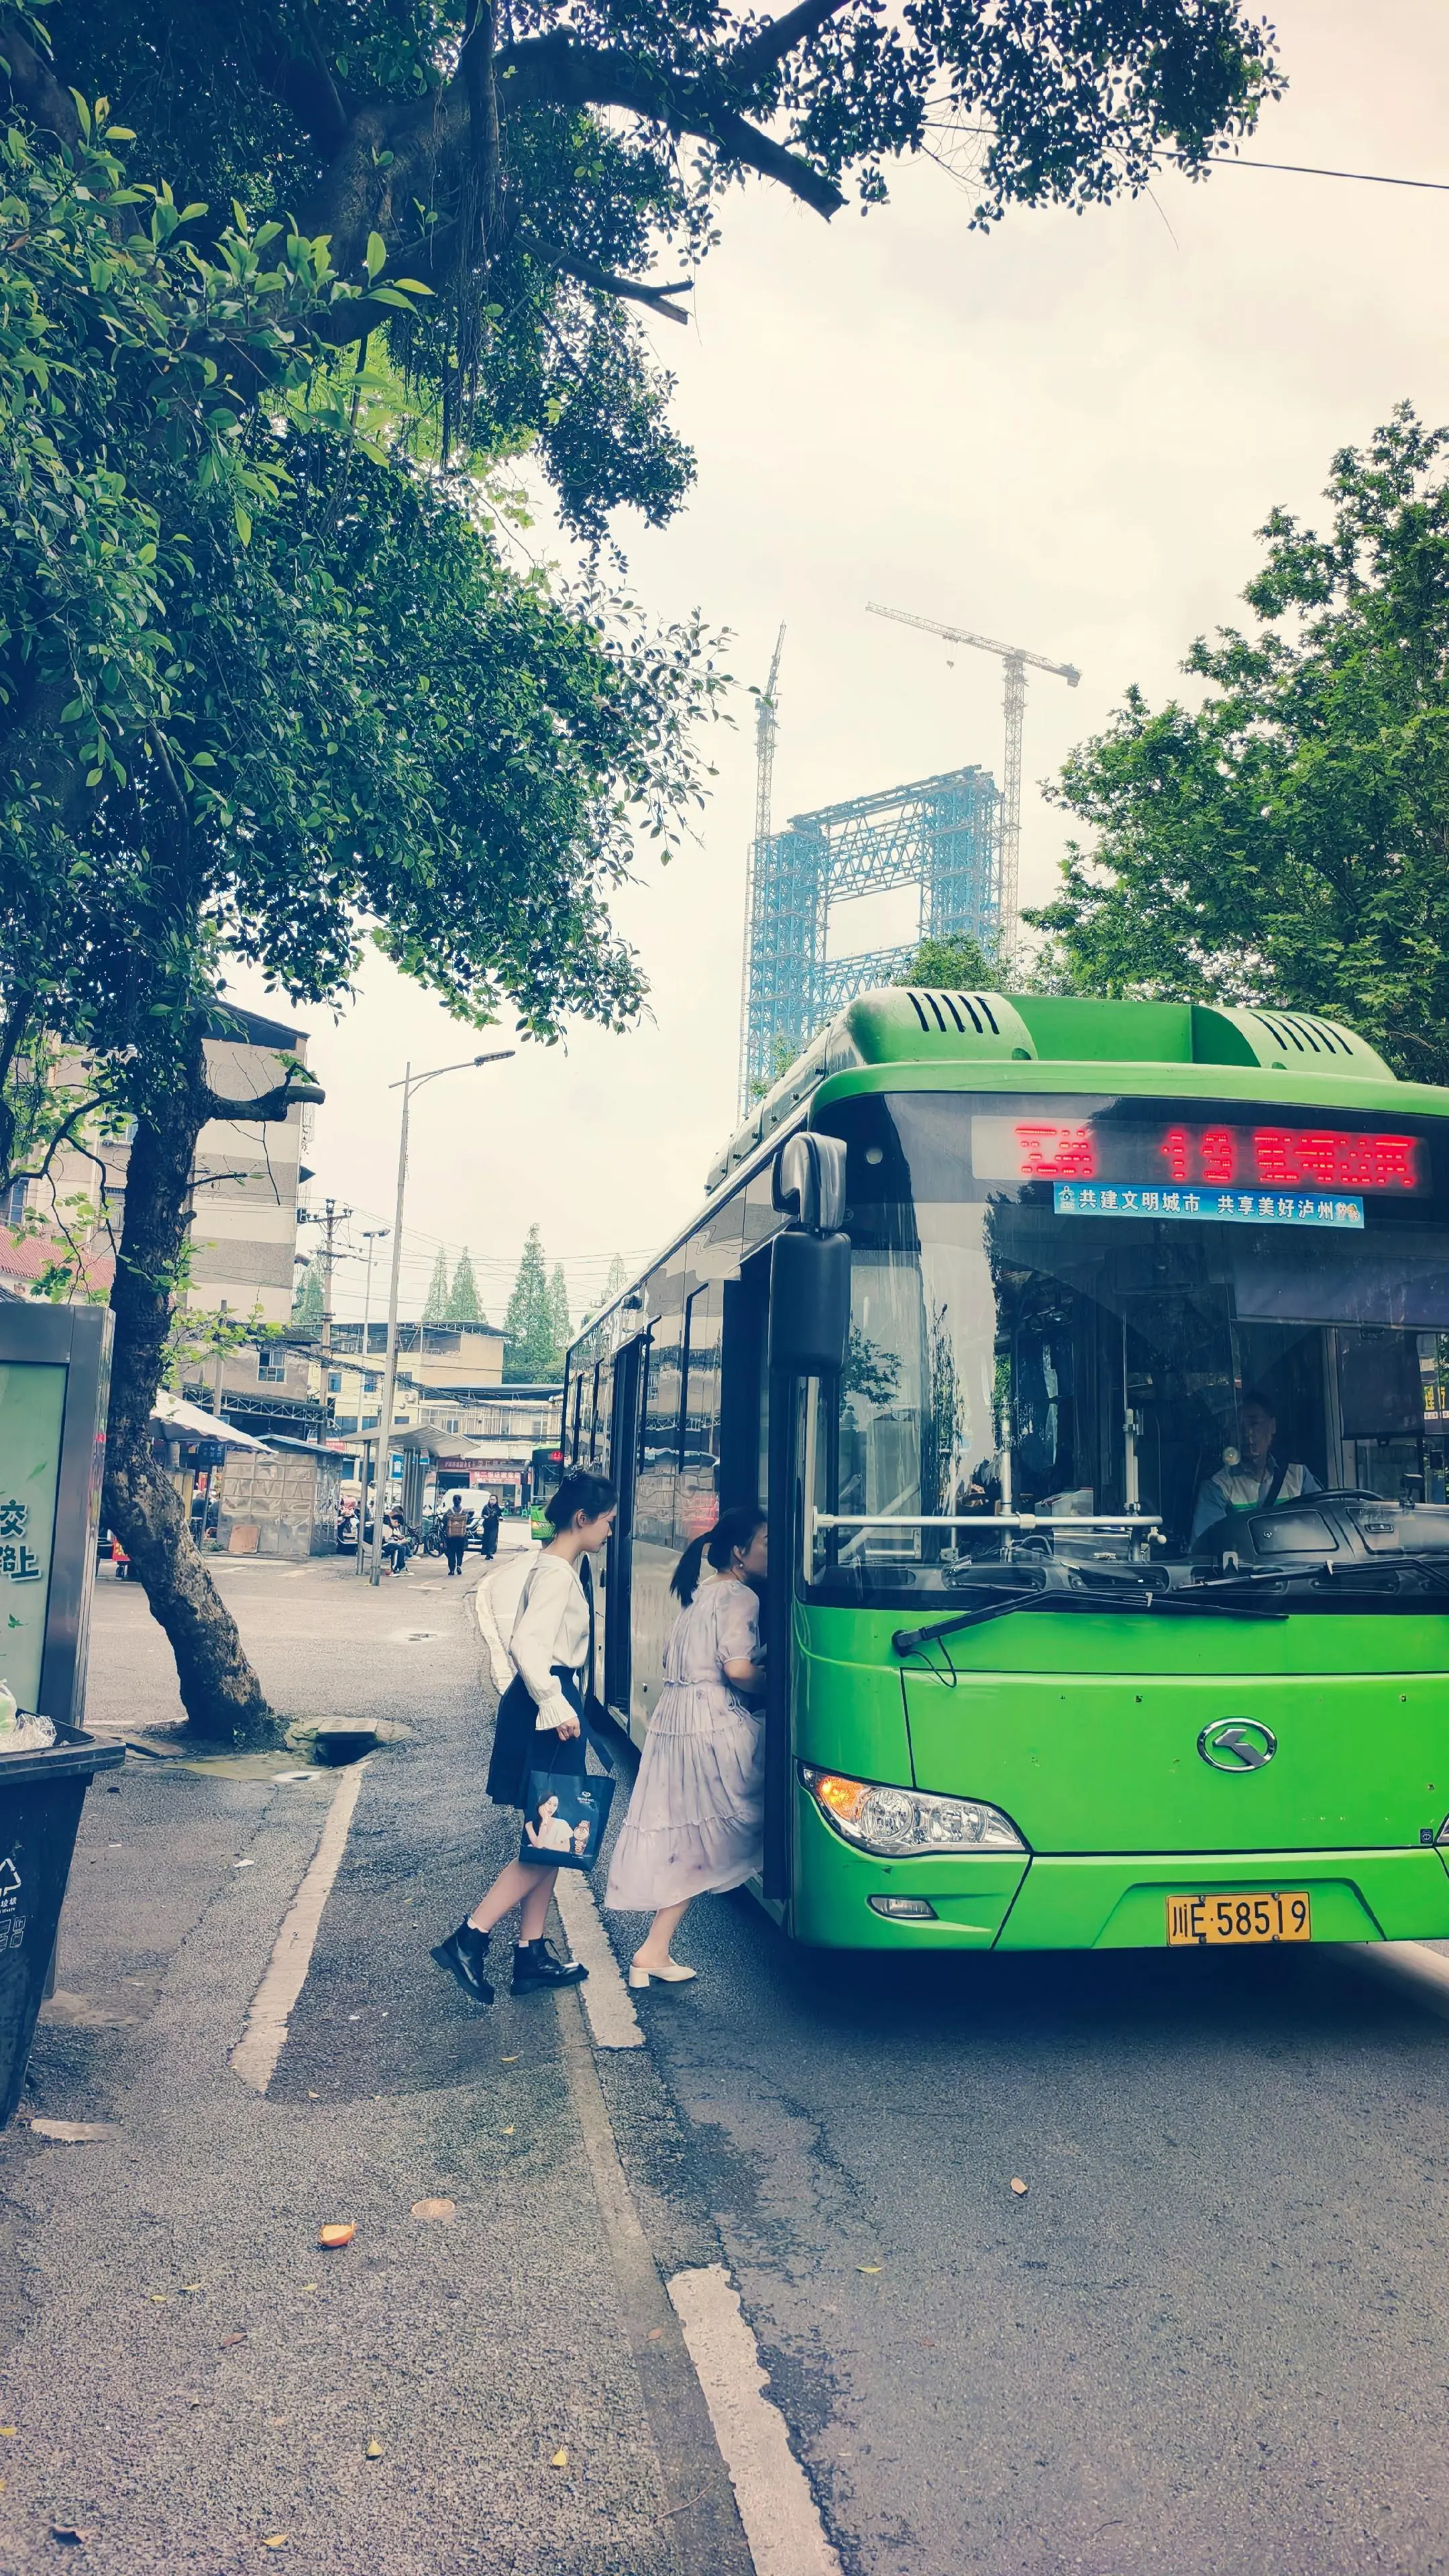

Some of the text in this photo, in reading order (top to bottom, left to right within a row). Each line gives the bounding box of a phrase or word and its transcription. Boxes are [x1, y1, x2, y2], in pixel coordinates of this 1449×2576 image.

[1079, 1189, 1334, 1220] 共建文明城市 共享美好泸州
